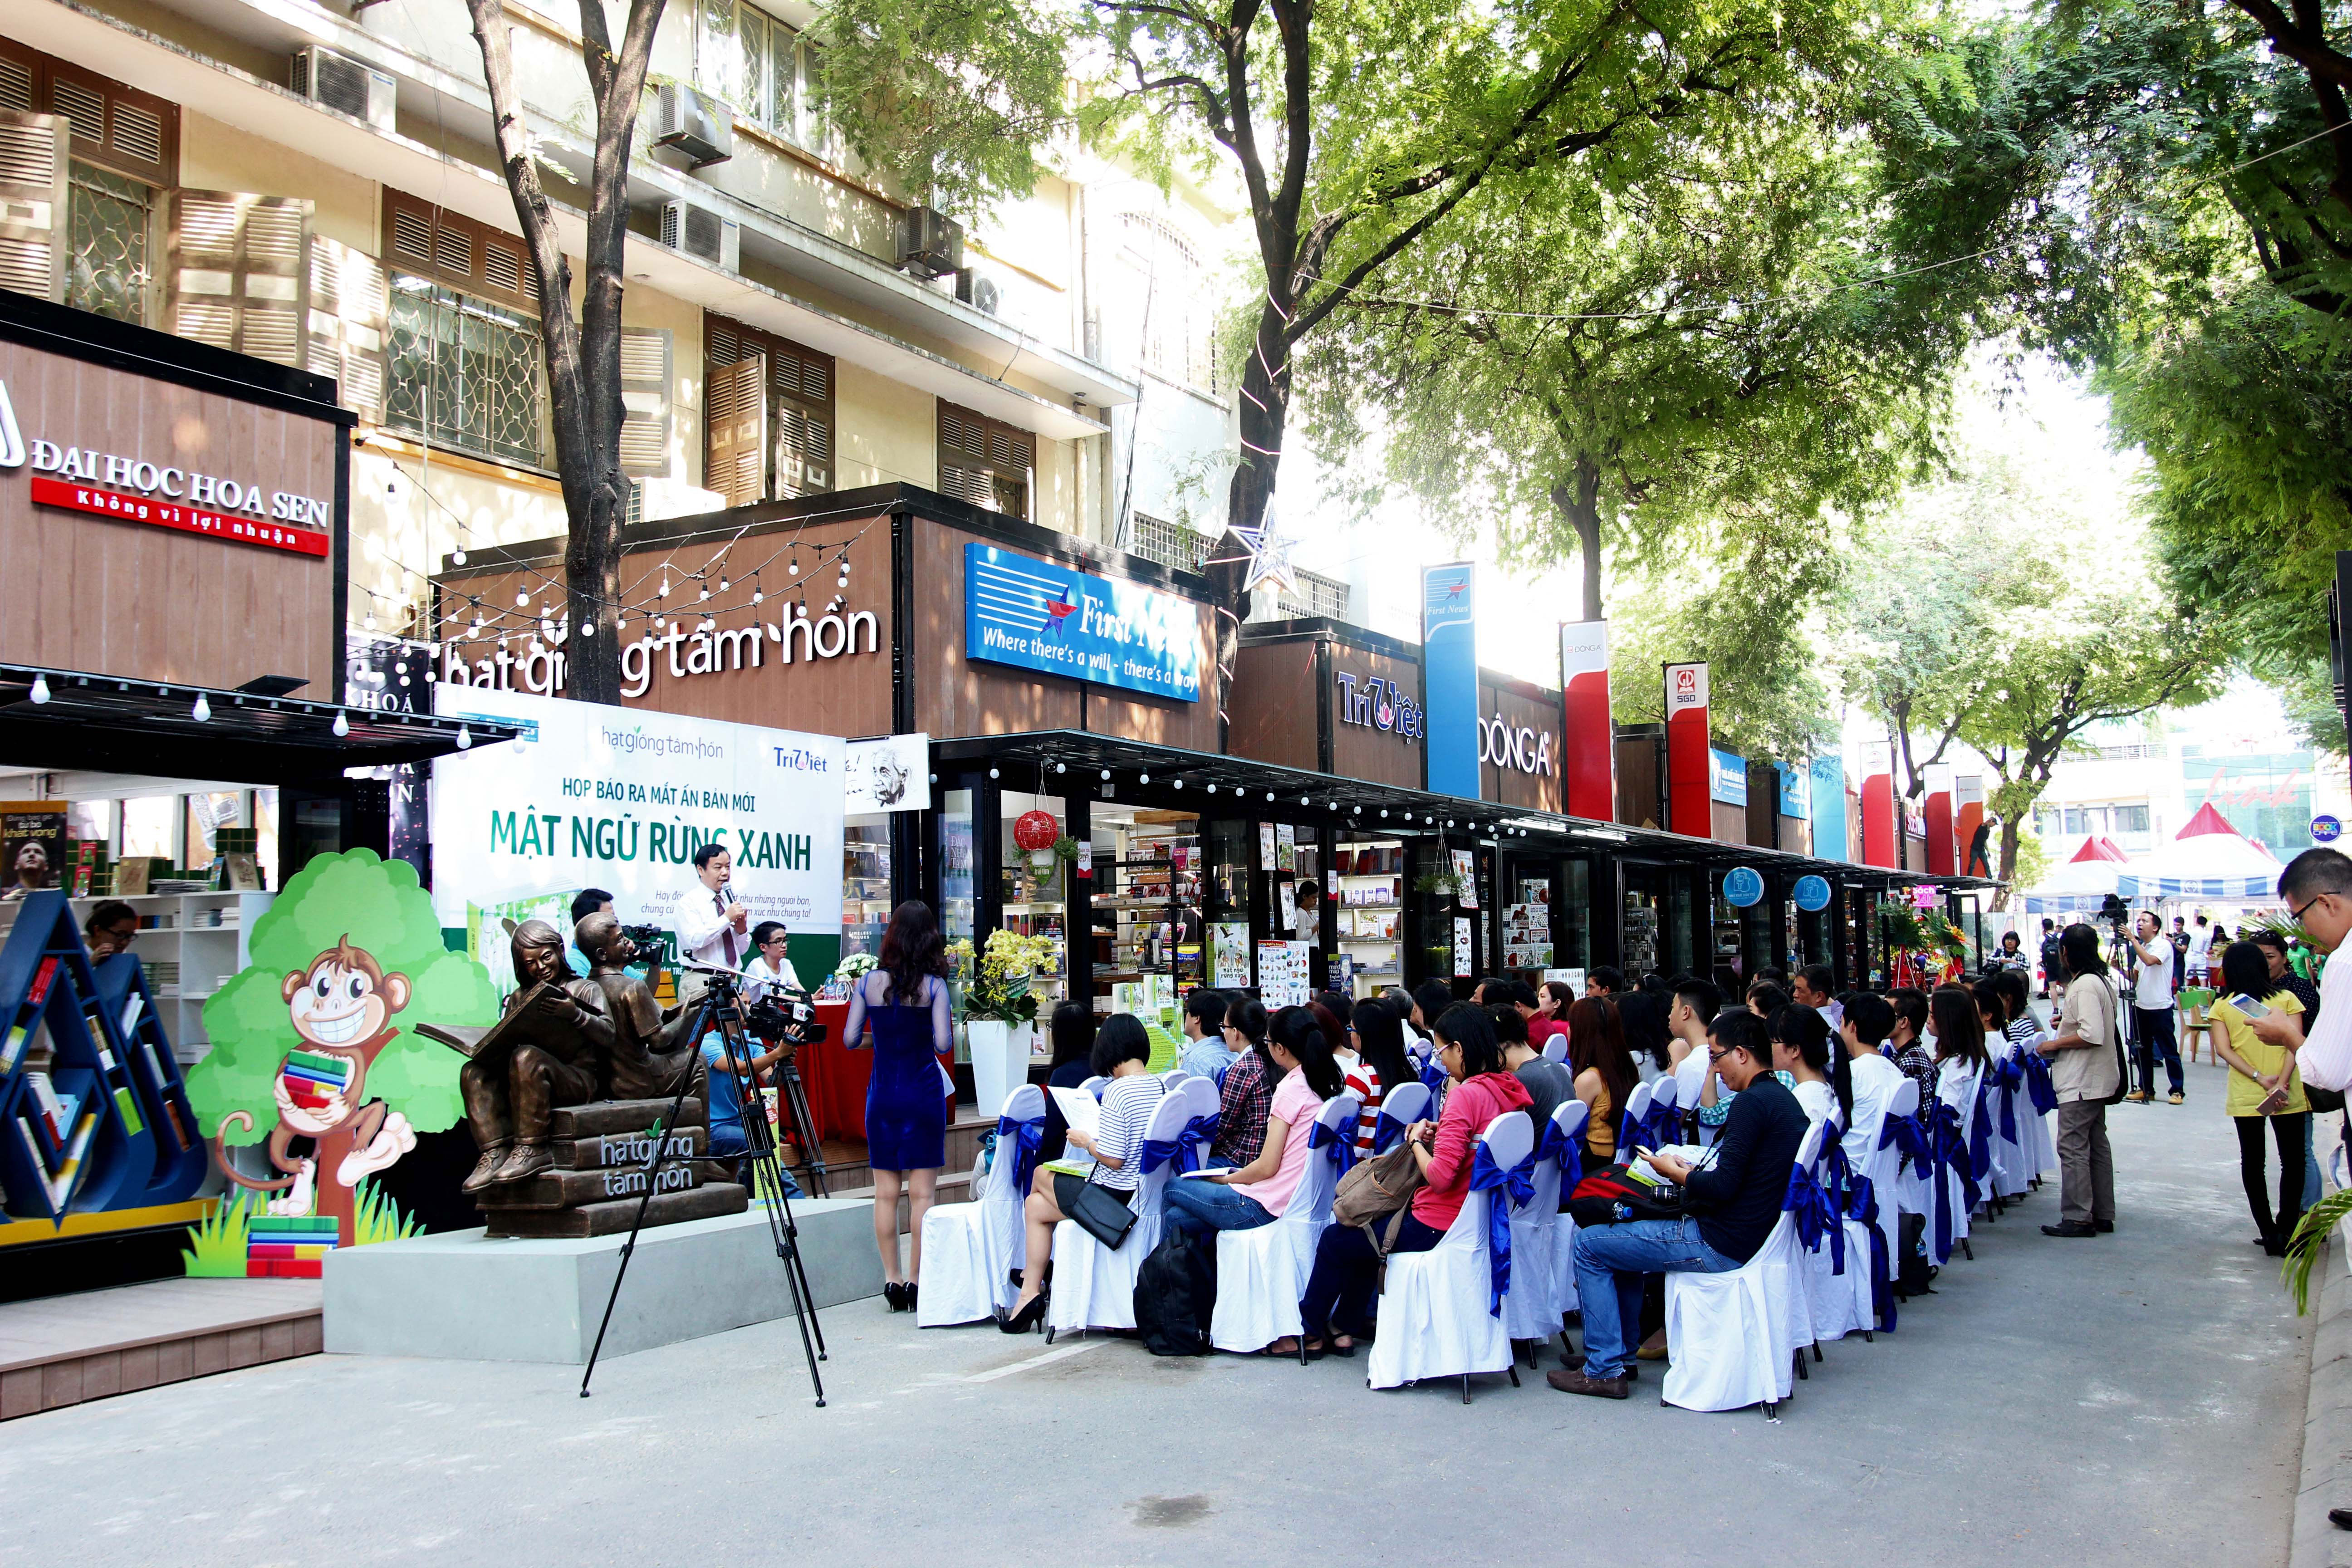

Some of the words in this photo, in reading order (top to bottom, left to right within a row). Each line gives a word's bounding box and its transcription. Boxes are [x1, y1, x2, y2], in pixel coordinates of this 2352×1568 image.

[31, 439, 99, 481] ĐẠI
[104, 455, 184, 497] HỌC
[189, 473, 266, 515] HOA
[271, 491, 329, 527] SEN
[78, 490, 149, 519] Không
[161, 505, 180, 522] vì
[192, 511, 221, 531] lợi
[233, 521, 297, 544] nhuận
[783, 594, 879, 664] hồn
[1079, 594, 1132, 644] First
[1427, 605, 1445, 616] First
[1447, 604, 1469, 614] News
[984, 626, 1027, 653] Where
[1031, 638, 1074, 663] there's
[1077, 652, 1085, 666] a
[1089, 652, 1110, 671] will
[1124, 659, 1161, 683] there's
[1164, 670, 1171, 684] a
[563, 777, 591, 800] HỌP
[597, 778, 624, 801] BÁO
[629, 784, 646, 802] RA
[651, 782, 678, 804] MẮT
[681, 783, 699, 807] ẤN
[703, 787, 727, 809] BẢN
[732, 793, 755, 812] MỚI
[490, 804, 562, 860] MẬT
[572, 813, 640, 862] NGỮ
[737, 828, 811, 871] XANH
[603, 1168, 647, 1196] tâm
